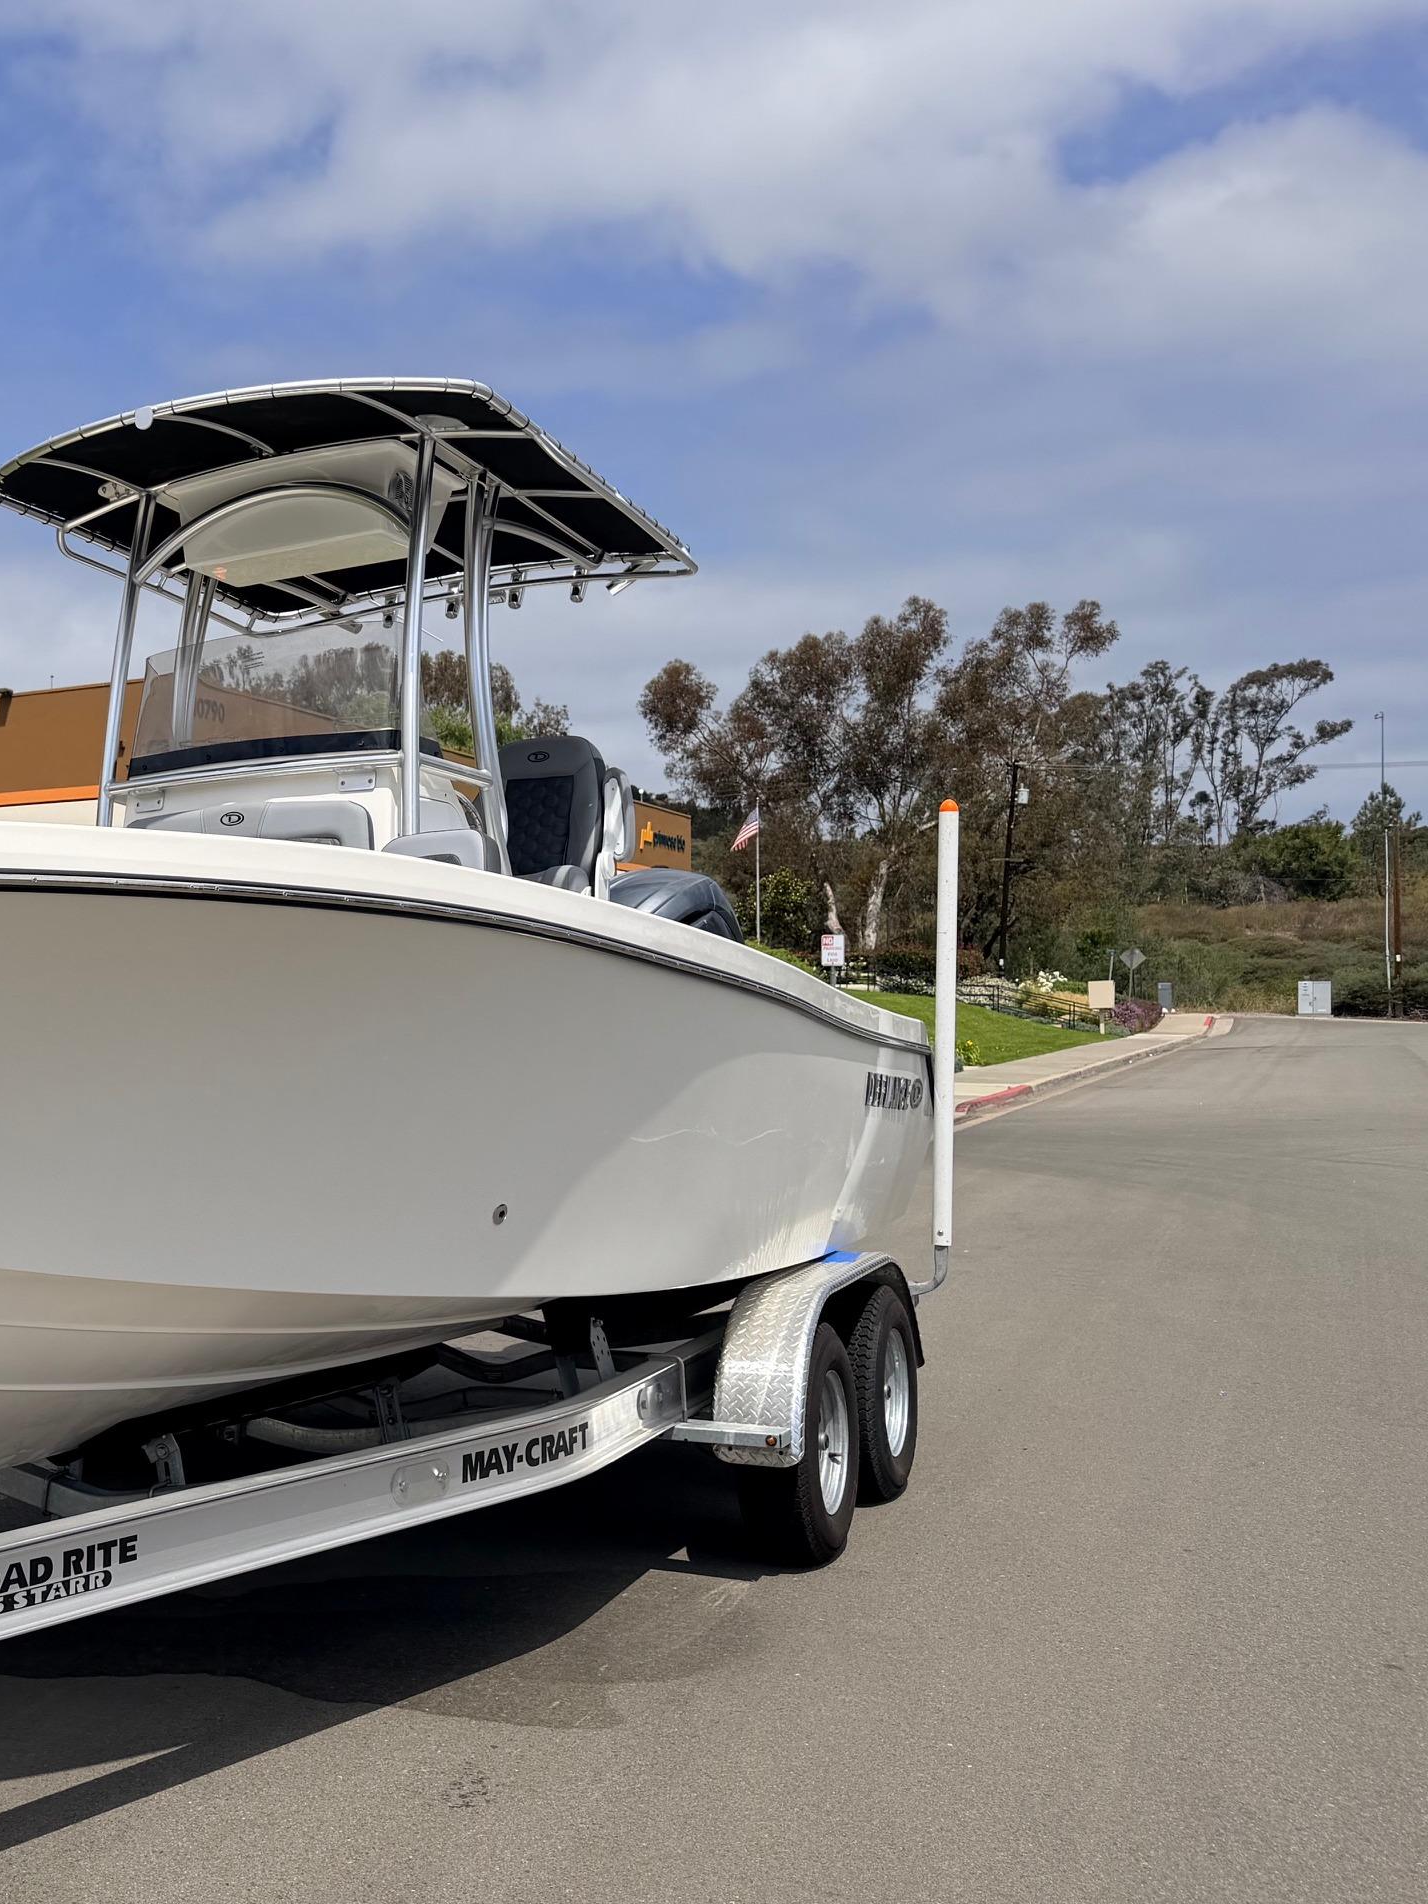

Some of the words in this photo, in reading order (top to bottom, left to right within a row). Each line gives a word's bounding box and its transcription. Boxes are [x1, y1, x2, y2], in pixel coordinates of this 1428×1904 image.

[461, 1421, 589, 1484] MAY-CRAFT
[62, 1534, 138, 1578] RITE
[13, 1571, 106, 1610] STARR
